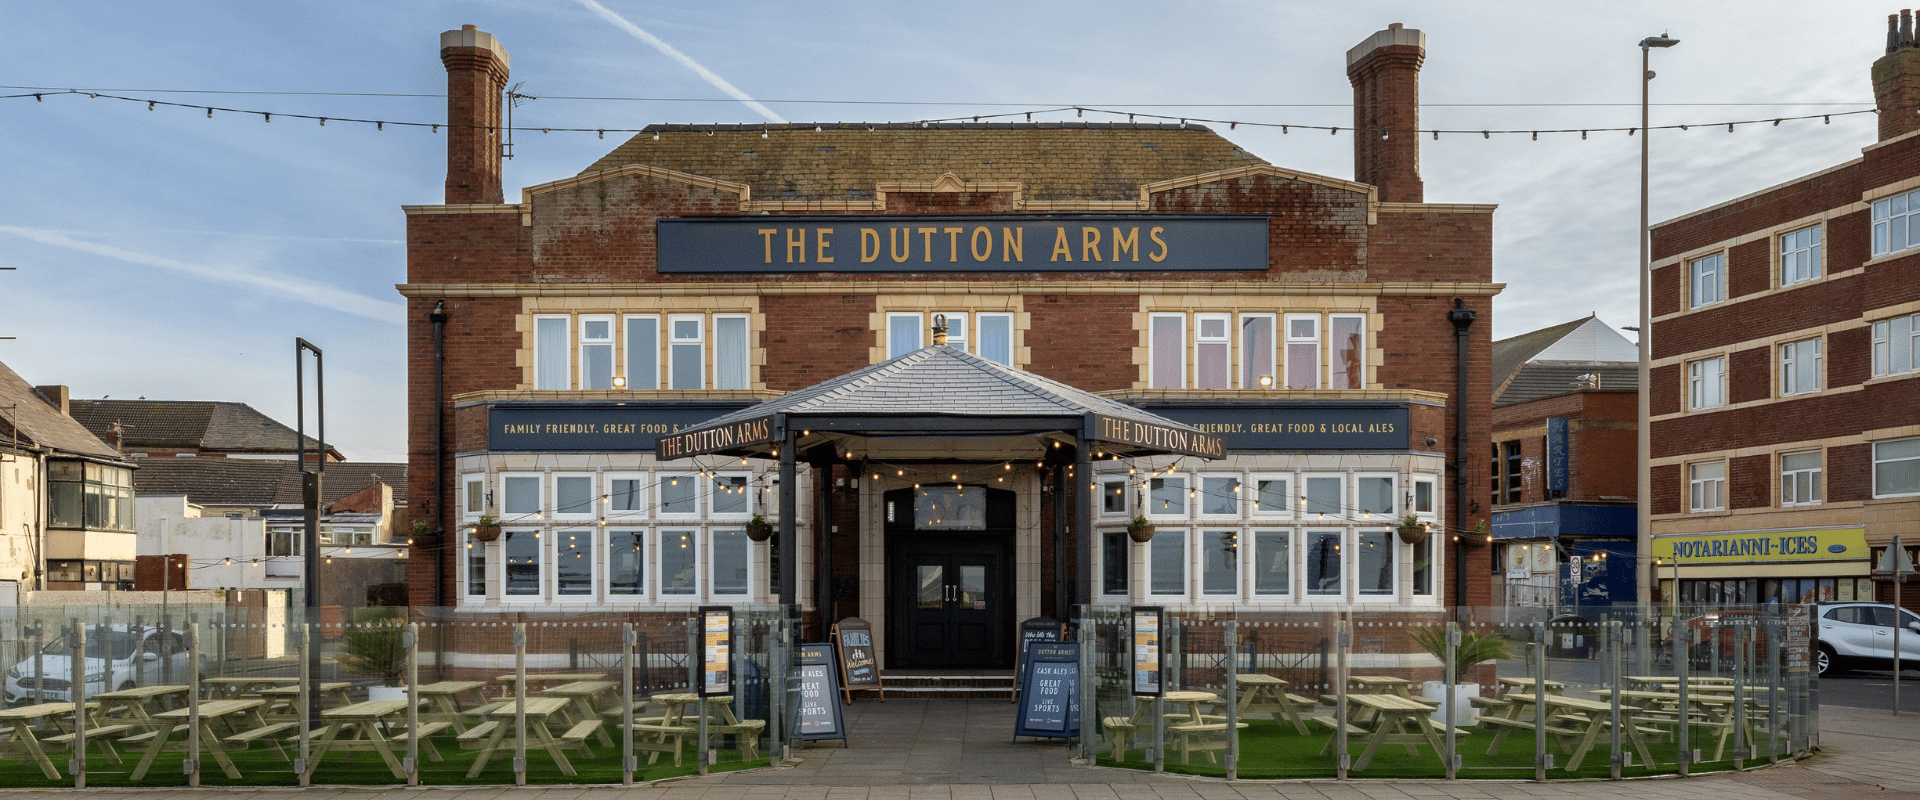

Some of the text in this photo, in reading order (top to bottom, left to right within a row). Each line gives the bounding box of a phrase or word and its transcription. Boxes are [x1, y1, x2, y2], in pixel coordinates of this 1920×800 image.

[758, 226, 1170, 264] THE DUTTON ARMS
[504, 424, 541, 434] FAMILY
[603, 424, 636, 434] GREAT
[640, 424, 668, 434] FOOD
[1250, 423, 1284, 433] GREAT
[1288, 423, 1316, 433] FOOD
[1320, 423, 1328, 433] &
[1332, 423, 1364, 433] LOCAL
[1368, 423, 1395, 433] ALES
[660, 418, 769, 458] THE DUTTON ARMS
[1102, 416, 1222, 456] THE DUTTON ARMS
[843, 632, 870, 647] FAMILIES
[799, 707, 826, 716] SPORTS
[1034, 704, 1060, 712] SPORTS
